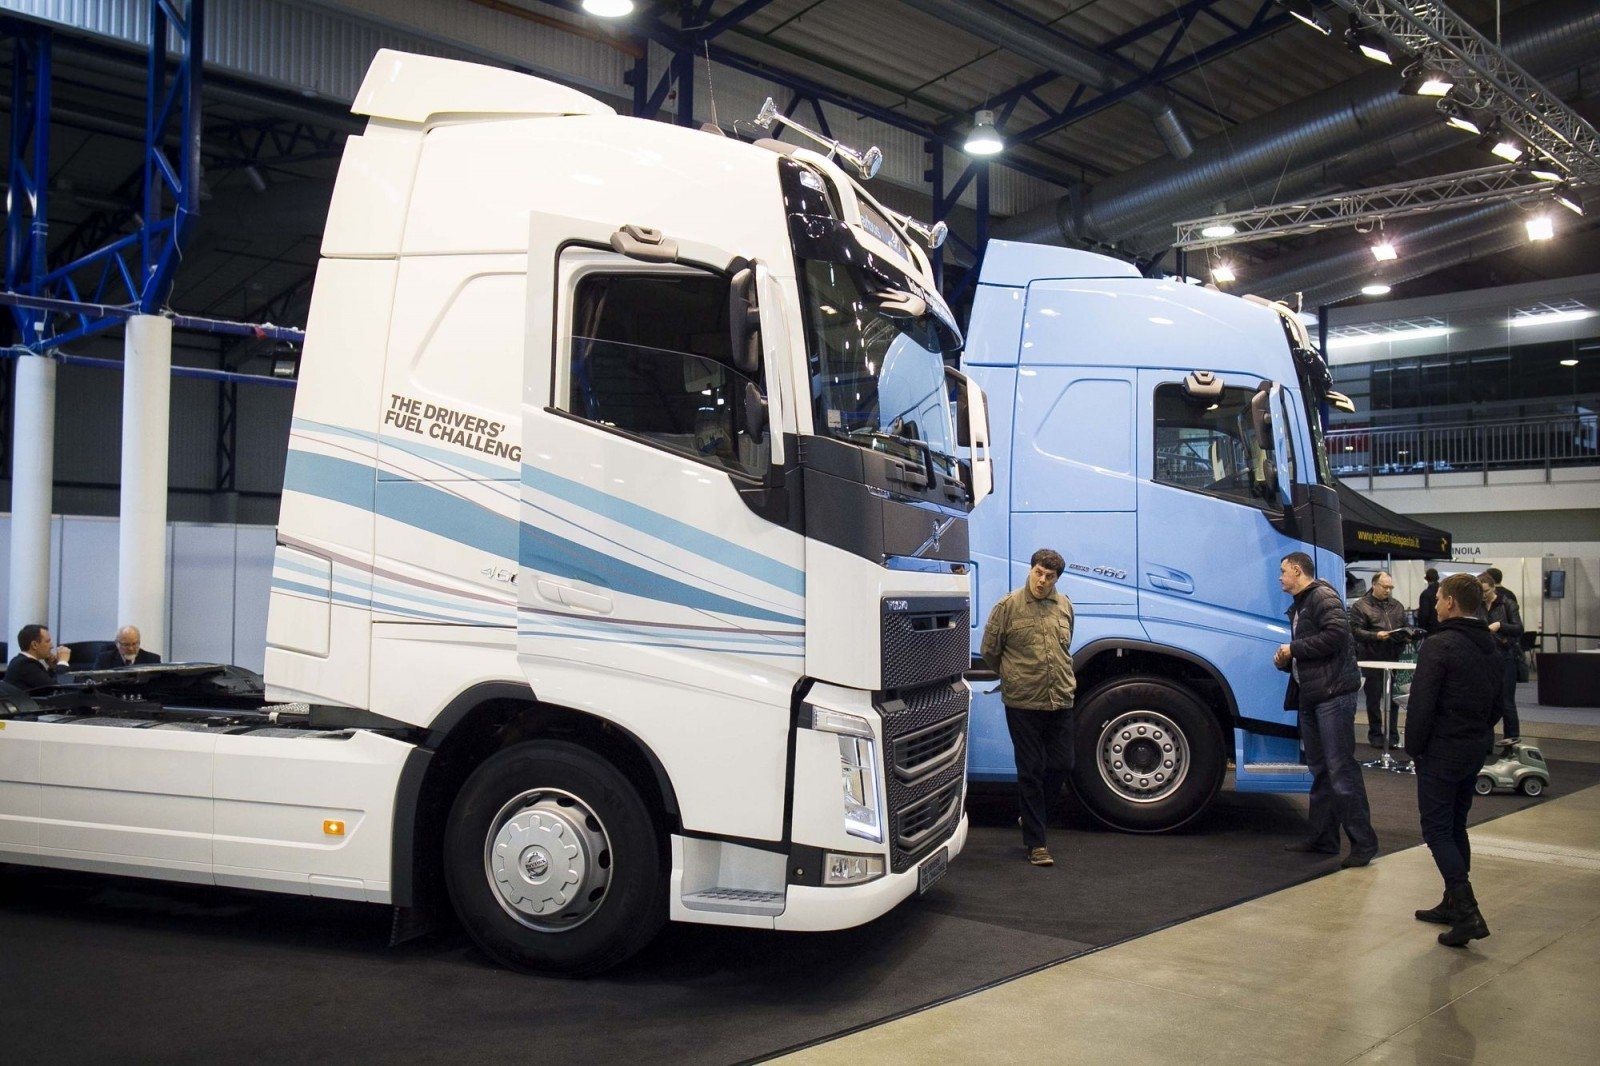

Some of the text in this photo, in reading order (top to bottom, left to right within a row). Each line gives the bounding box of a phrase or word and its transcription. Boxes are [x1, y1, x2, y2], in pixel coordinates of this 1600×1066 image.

[384, 410, 521, 462] FUEL CHALLENG
[391, 394, 505, 438] THE DRIVERS'
[1093, 566, 1127, 580] 460
